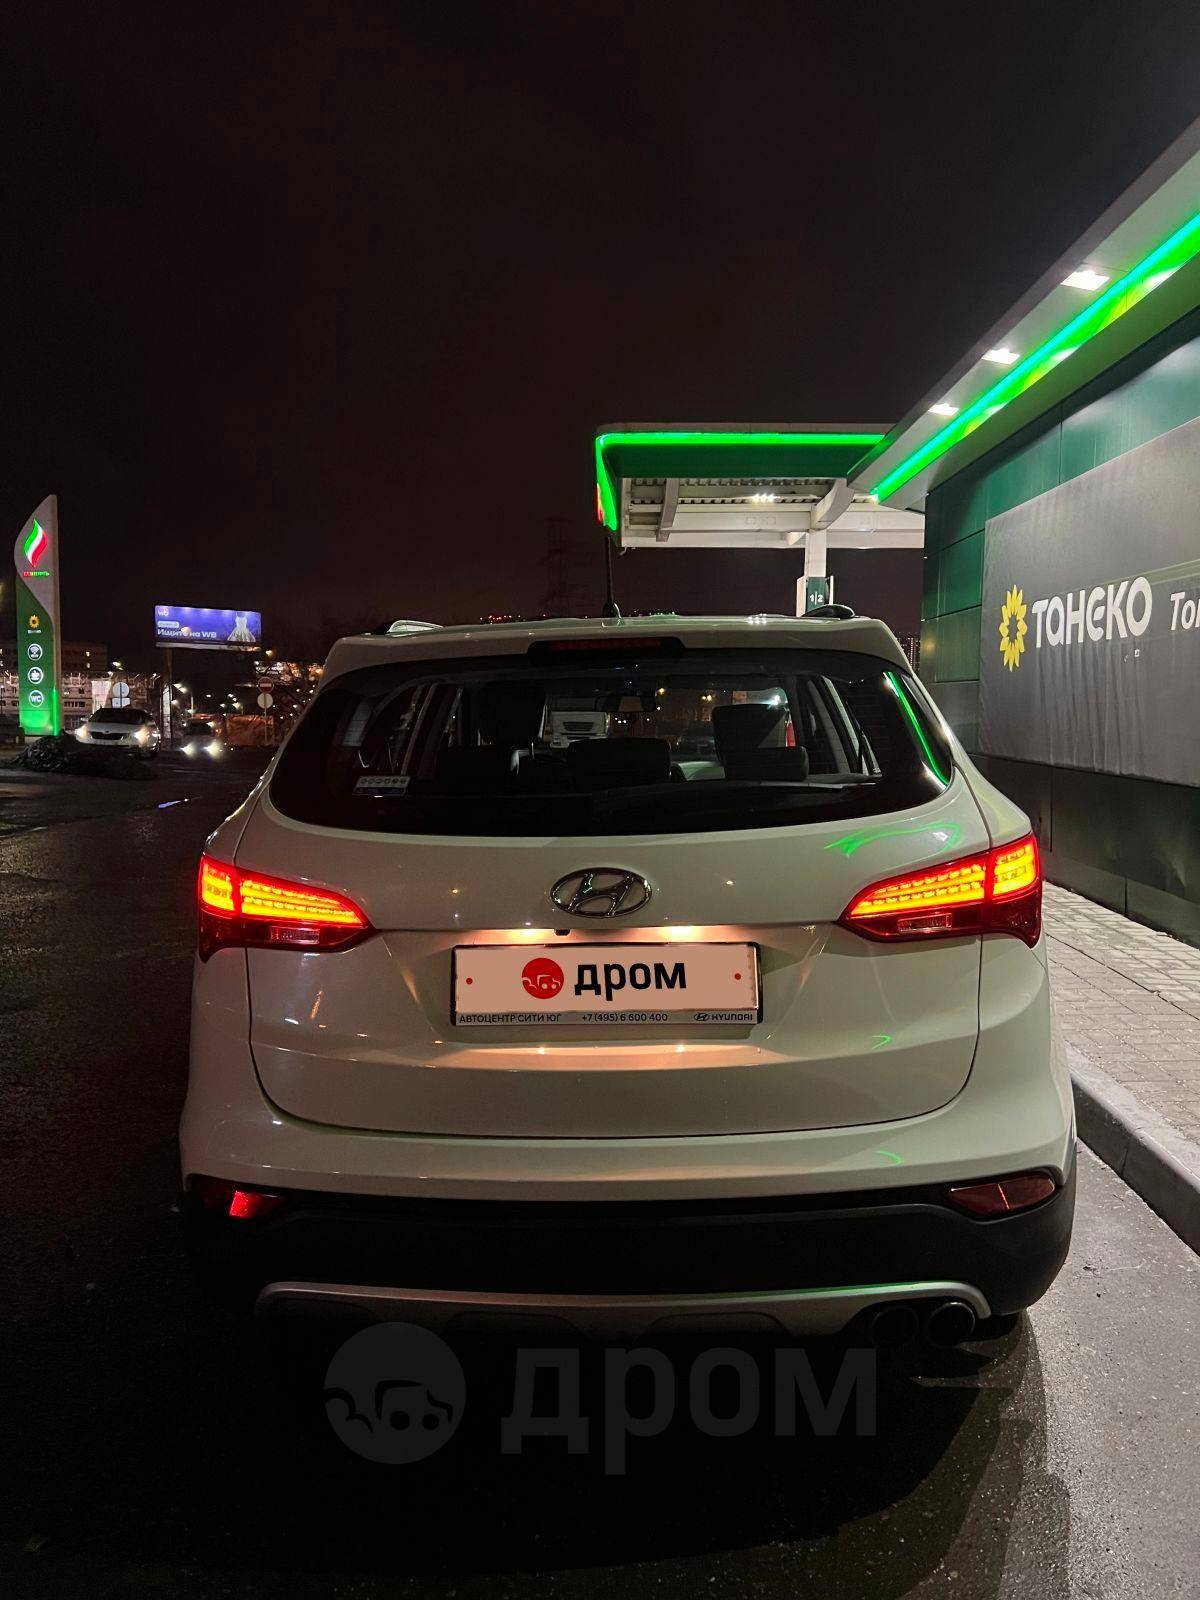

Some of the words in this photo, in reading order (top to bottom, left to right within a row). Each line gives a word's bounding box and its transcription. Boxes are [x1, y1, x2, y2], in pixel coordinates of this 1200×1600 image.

[459, 1014, 515, 1023] АВТОЦЕНТР
[517, 1014, 545, 1023] СИТИ
[547, 1014, 561, 1022] ЮГ
[582, 1013, 592, 1022] +7
[594, 1013, 618, 1022] (495)
[620, 1013, 626, 1022] 6
[628, 1013, 647, 1022] 600
[649, 1013, 668, 1021] 400
[711, 1013, 753, 1021] HYUNDAI
